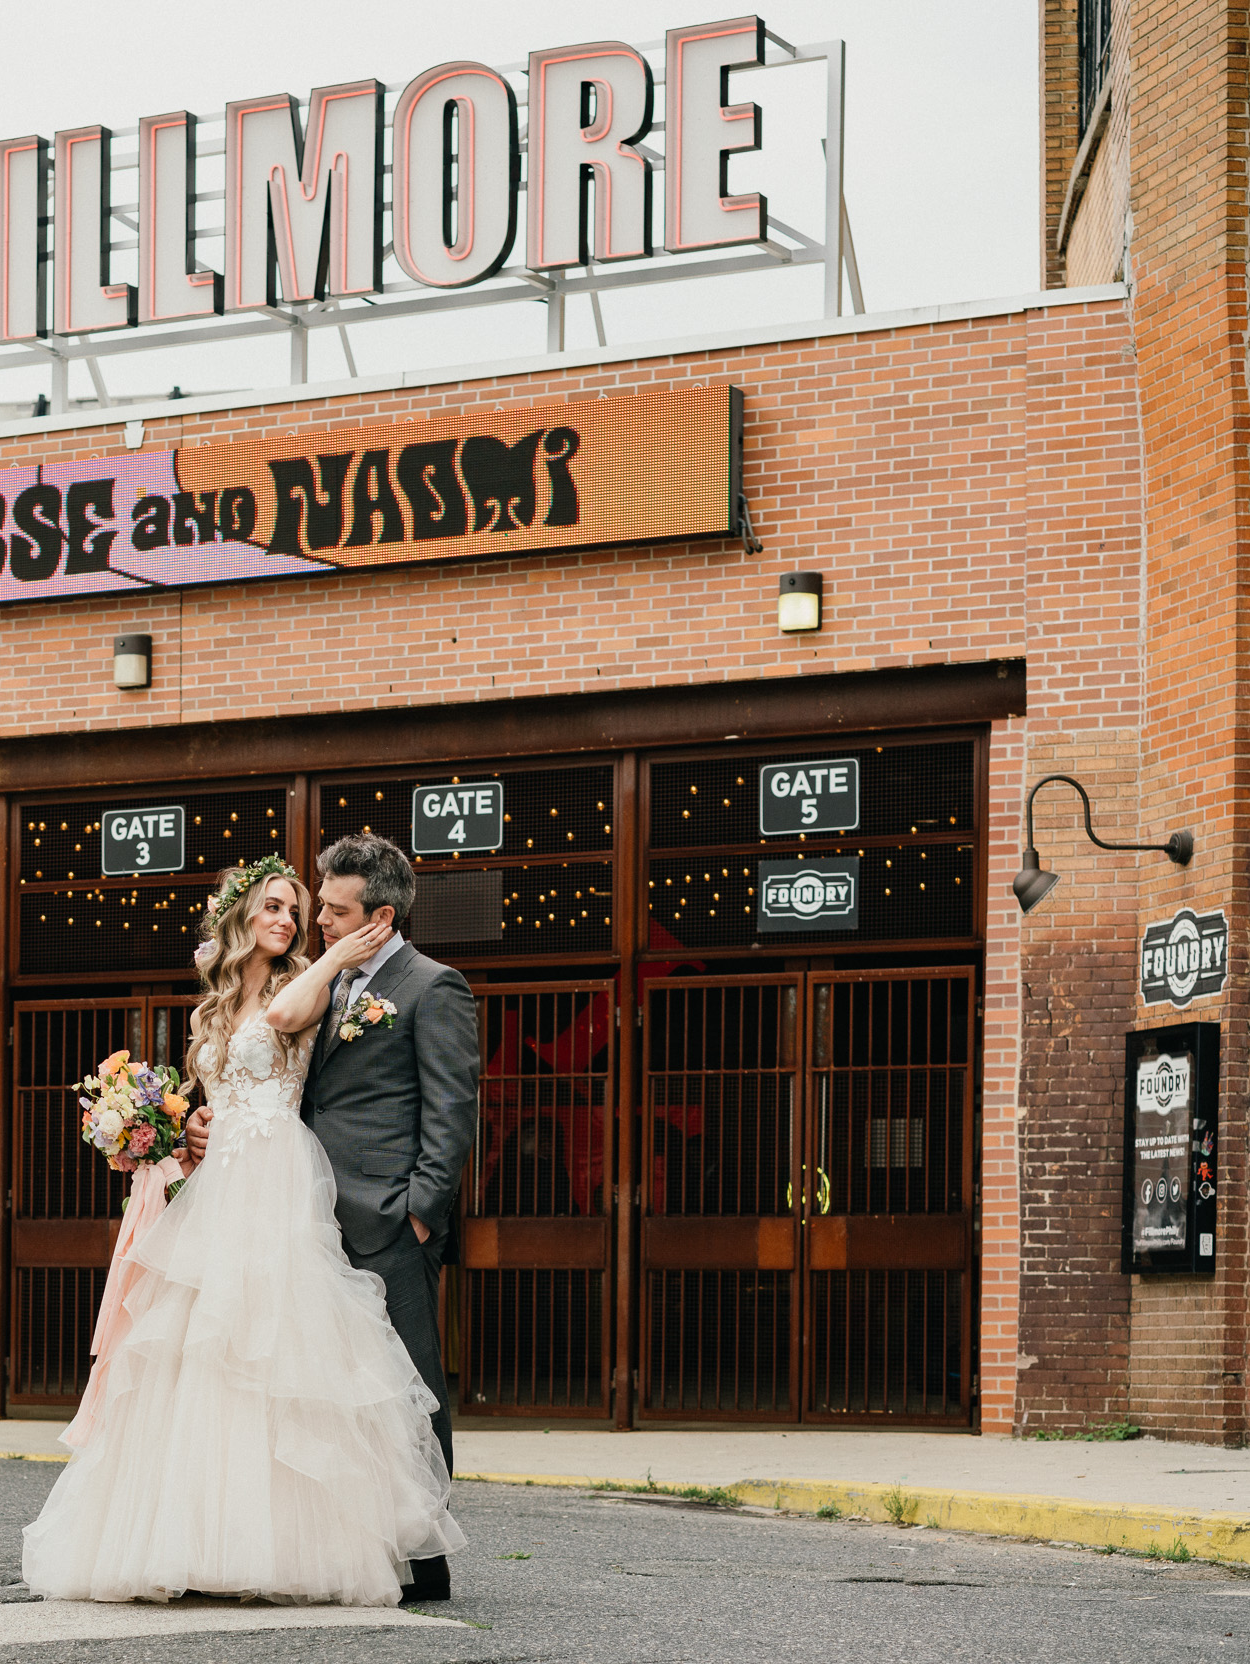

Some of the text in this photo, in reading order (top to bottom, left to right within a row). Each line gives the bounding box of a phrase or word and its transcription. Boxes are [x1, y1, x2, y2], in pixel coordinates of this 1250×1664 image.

[267, 427, 581, 555] NAOMI
[770, 767, 849, 797] GATE
[422, 790, 493, 818] GATE
[801, 798, 818, 824] 5
[111, 813, 175, 840] GATE
[447, 819, 466, 843] 4
[135, 842, 150, 865] 3
[767, 886, 849, 903] FOUNDRY
[1143, 936, 1225, 979] FOUNDRY
[1140, 1073, 1187, 1096] FOUNDRY
[1135, 1137, 1149, 1148] STAY
[1149, 1136, 1157, 1146] UP
[1157, 1136, 1164, 1146] TO
[1164, 1135, 1177, 1145] DATE
[1140, 1149, 1150, 1160] THE
[1151, 1148, 1169, 1159] LATEST
